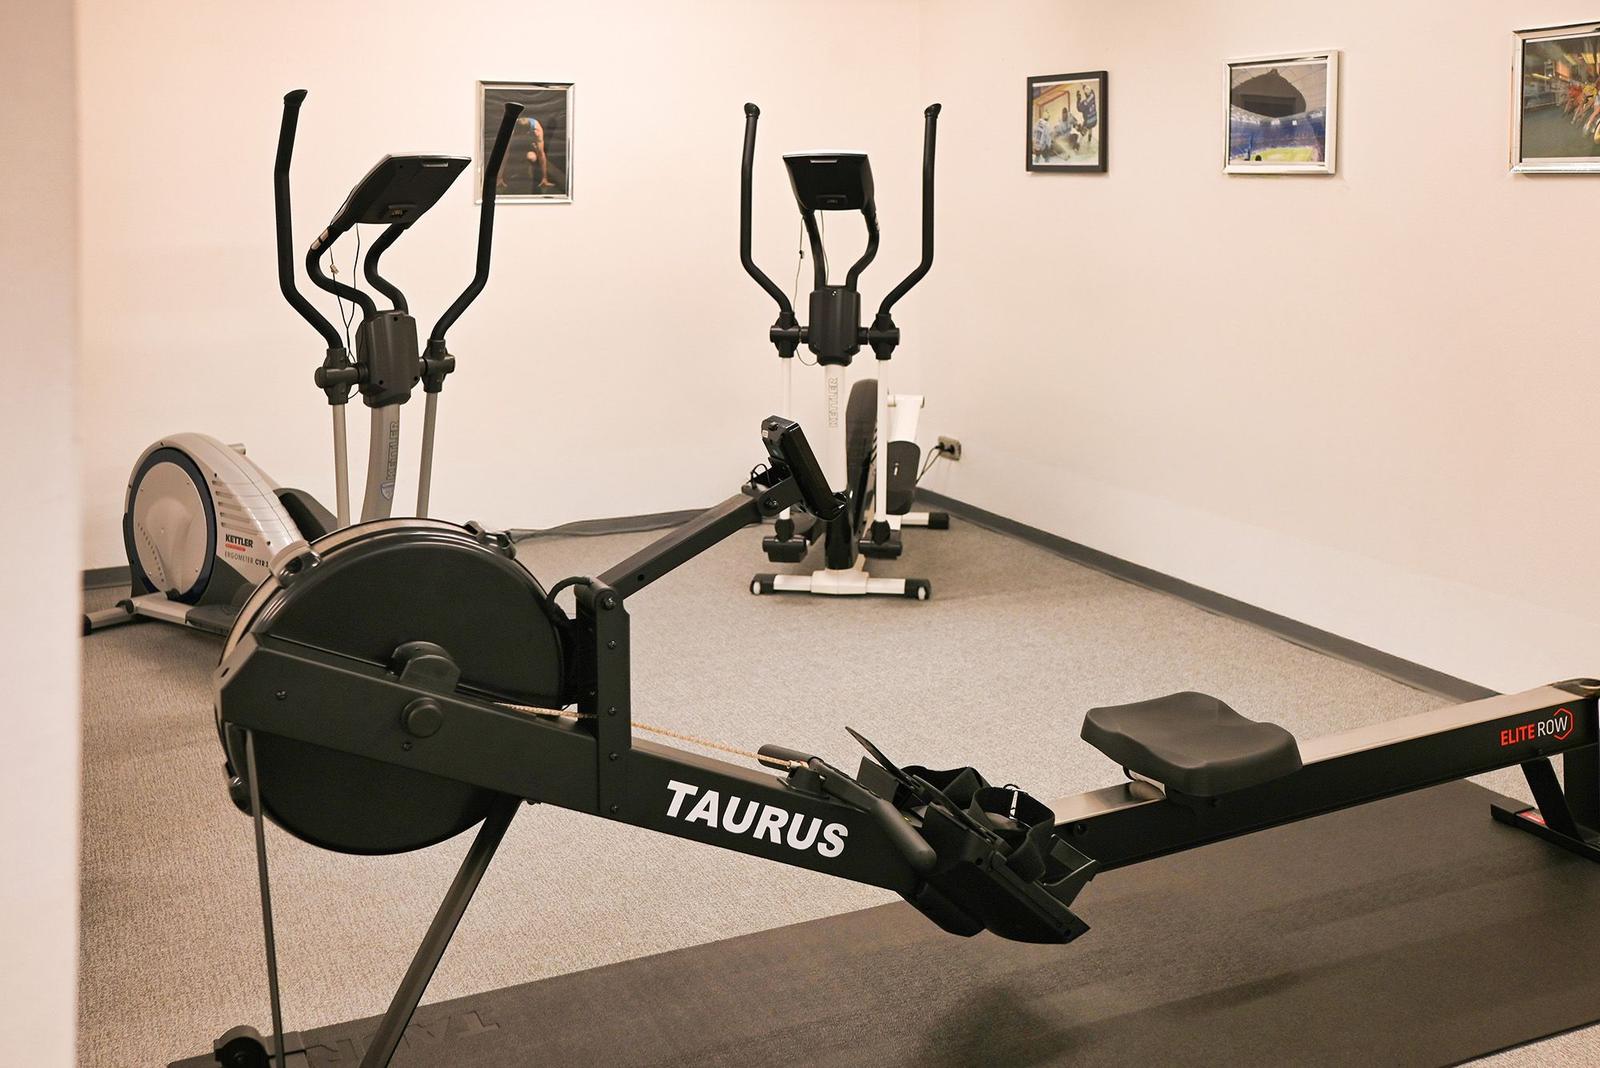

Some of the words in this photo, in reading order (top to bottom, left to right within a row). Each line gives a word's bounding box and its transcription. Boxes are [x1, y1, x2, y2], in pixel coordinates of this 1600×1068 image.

[828, 377, 839, 429] KETTLER
[386, 421, 400, 481] KETTLER
[224, 551, 254, 564] ERGOMETER
[225, 534, 254, 548] KETTLER
[1501, 723, 1535, 746] ELITE
[1537, 715, 1568, 737] ROW
[666, 779, 849, 858] TAURUS
